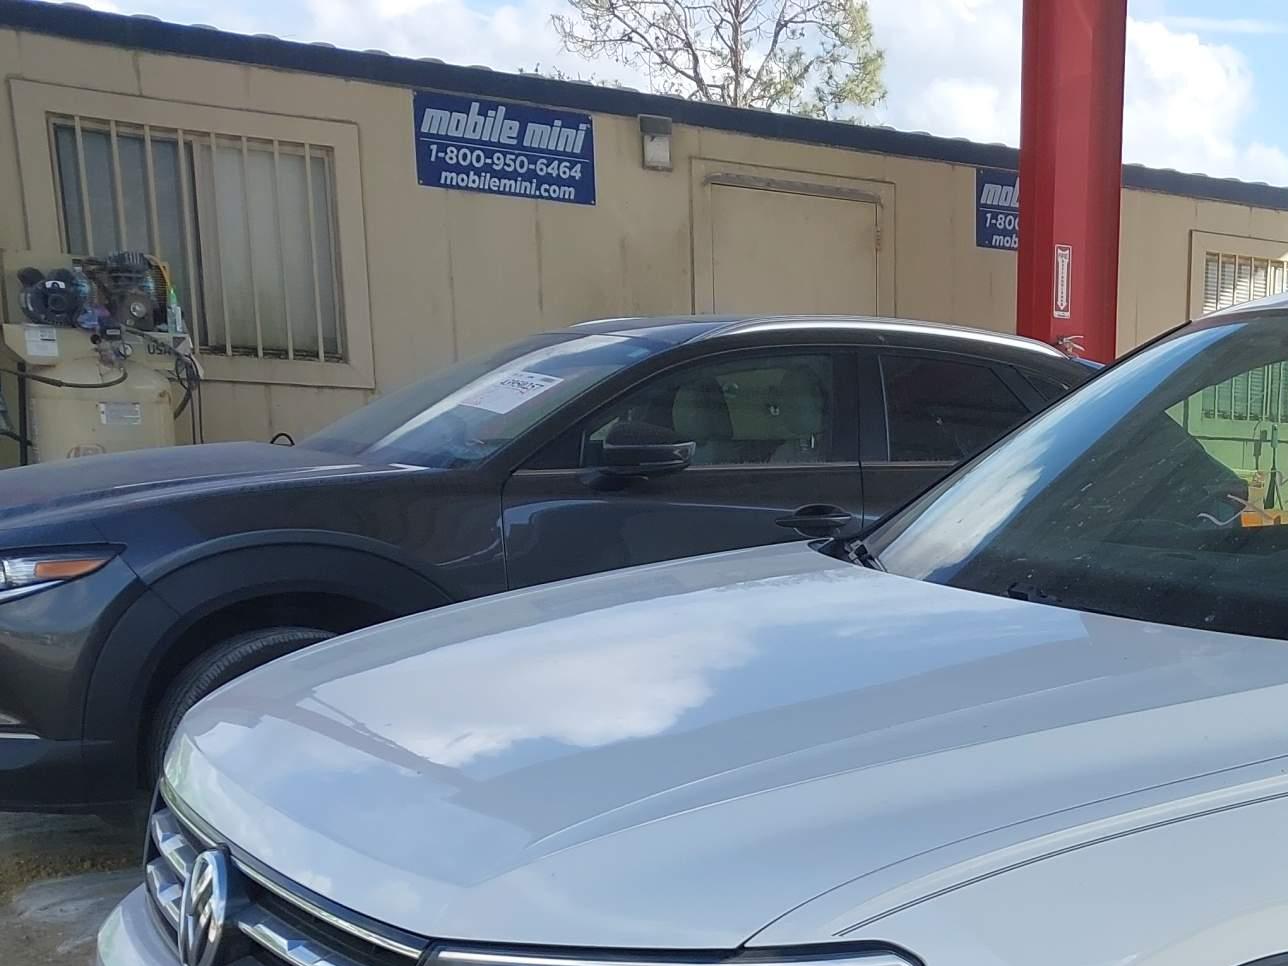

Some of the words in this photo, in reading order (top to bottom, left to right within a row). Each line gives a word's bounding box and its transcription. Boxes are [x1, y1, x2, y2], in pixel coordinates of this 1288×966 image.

[420, 101, 520, 145] mobile
[522, 119, 588, 153] mini
[429, 144, 582, 180] 1-800-950-6464
[440, 169, 576, 200] mobilemini.com
[980, 176, 1020, 207] mob
